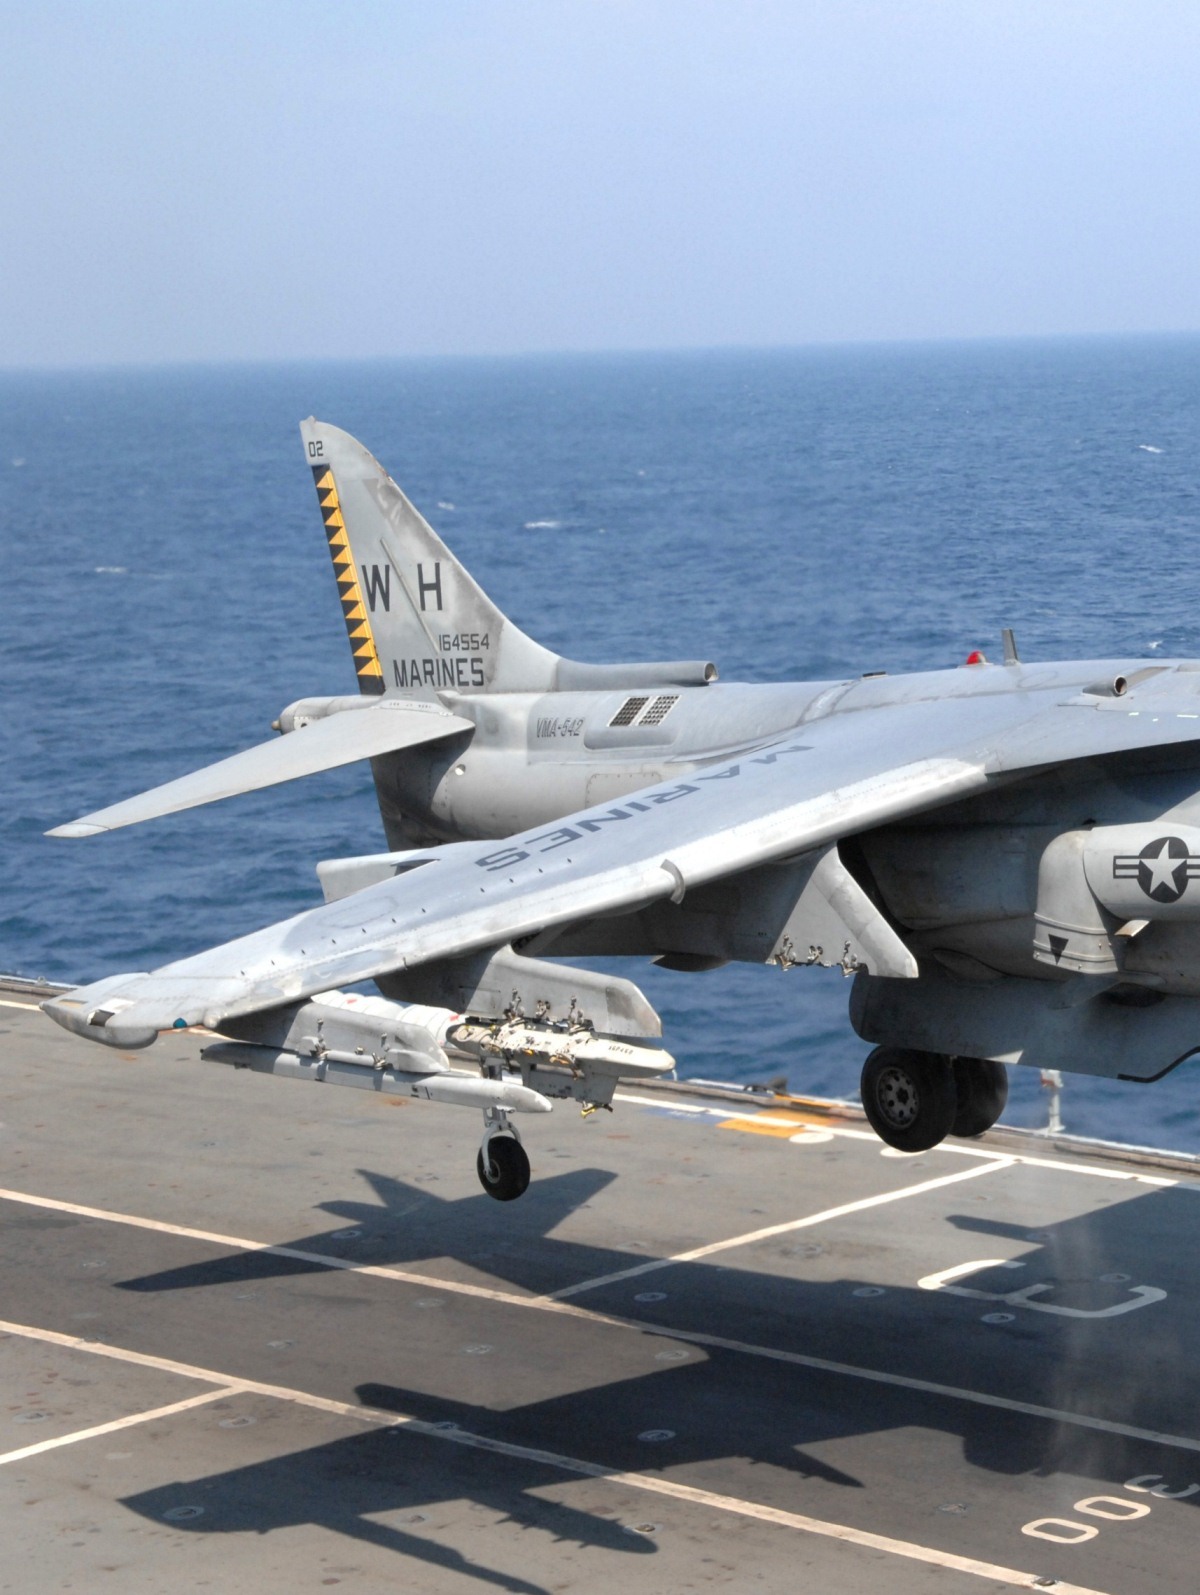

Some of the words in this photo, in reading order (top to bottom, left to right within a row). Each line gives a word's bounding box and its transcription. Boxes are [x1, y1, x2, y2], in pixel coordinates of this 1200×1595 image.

[308, 440, 325, 457] 02
[438, 633, 490, 651] 164554
[392, 658, 484, 687] MARINES
[536, 717, 585, 738] VMA-542
[474, 745, 815, 872] MARINES
[1021, 1474, 1200, 1544] 300
